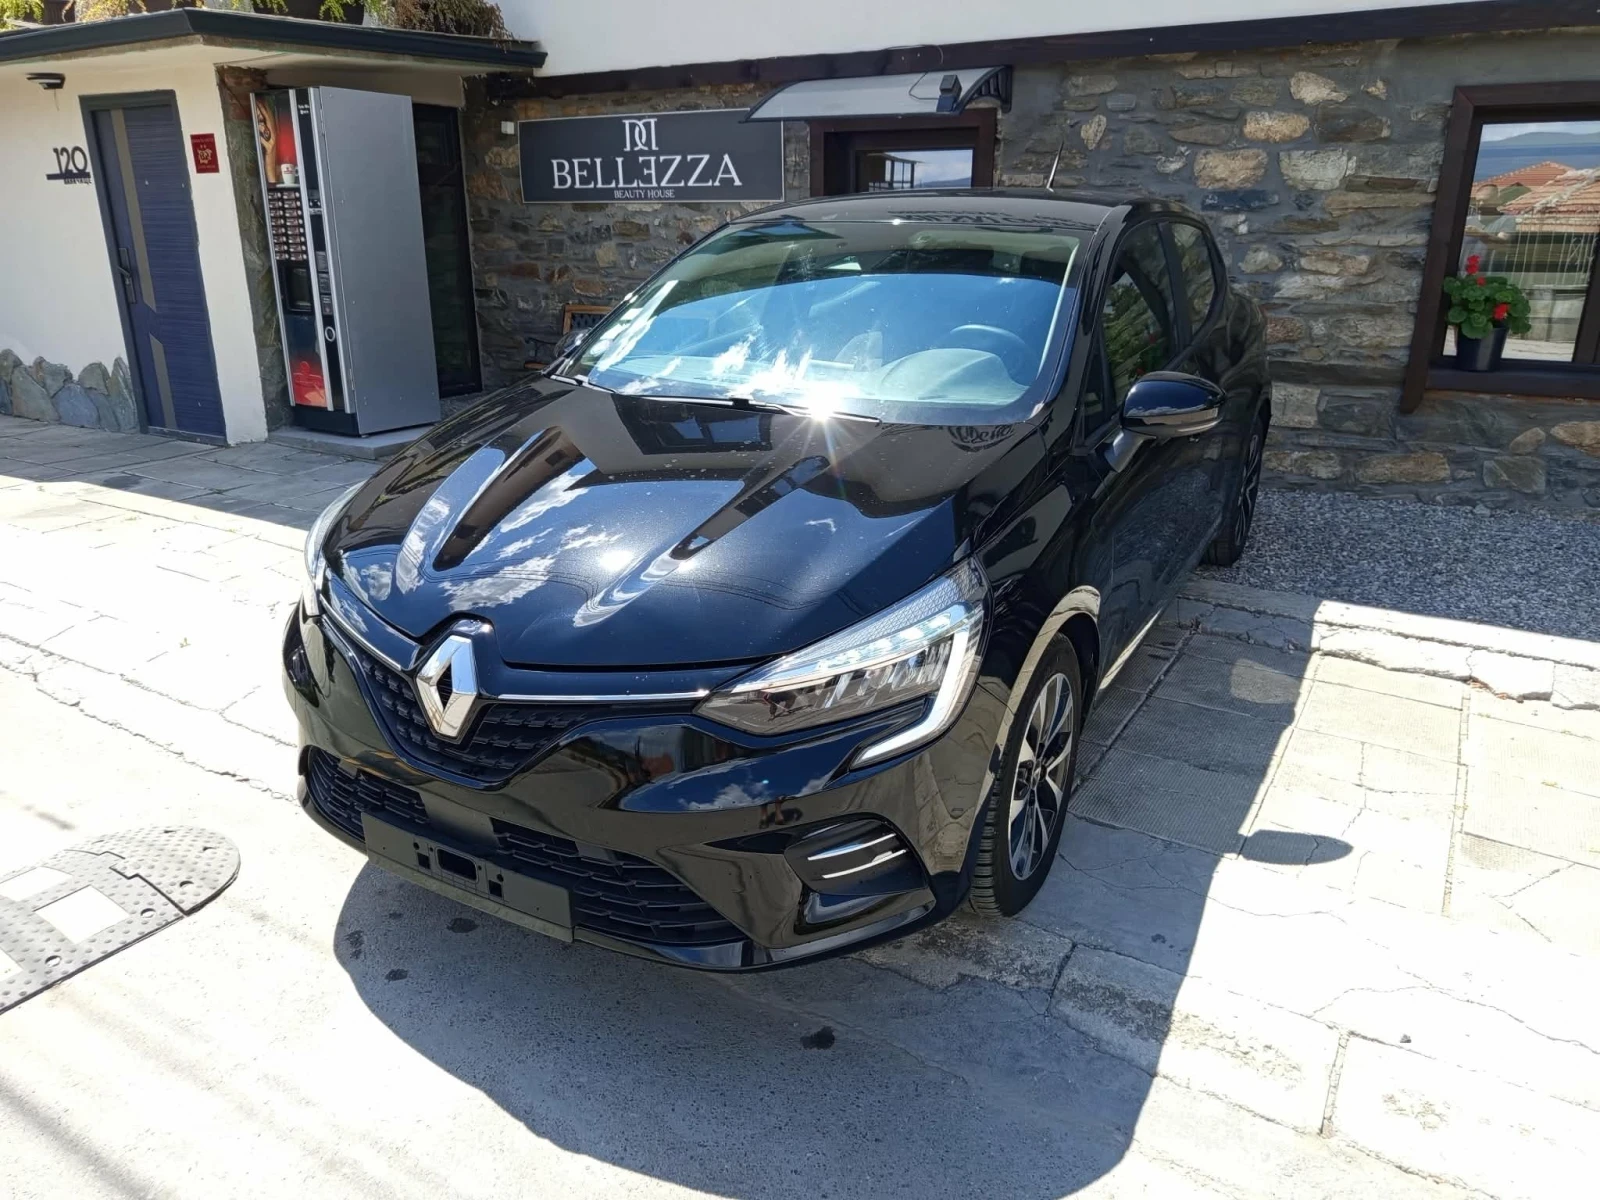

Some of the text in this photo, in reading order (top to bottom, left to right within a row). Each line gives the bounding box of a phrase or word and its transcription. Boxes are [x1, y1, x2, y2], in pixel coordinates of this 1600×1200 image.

[53, 146, 88, 175] 120
[614, 189, 675, 199] BEAUTY HOUSE
